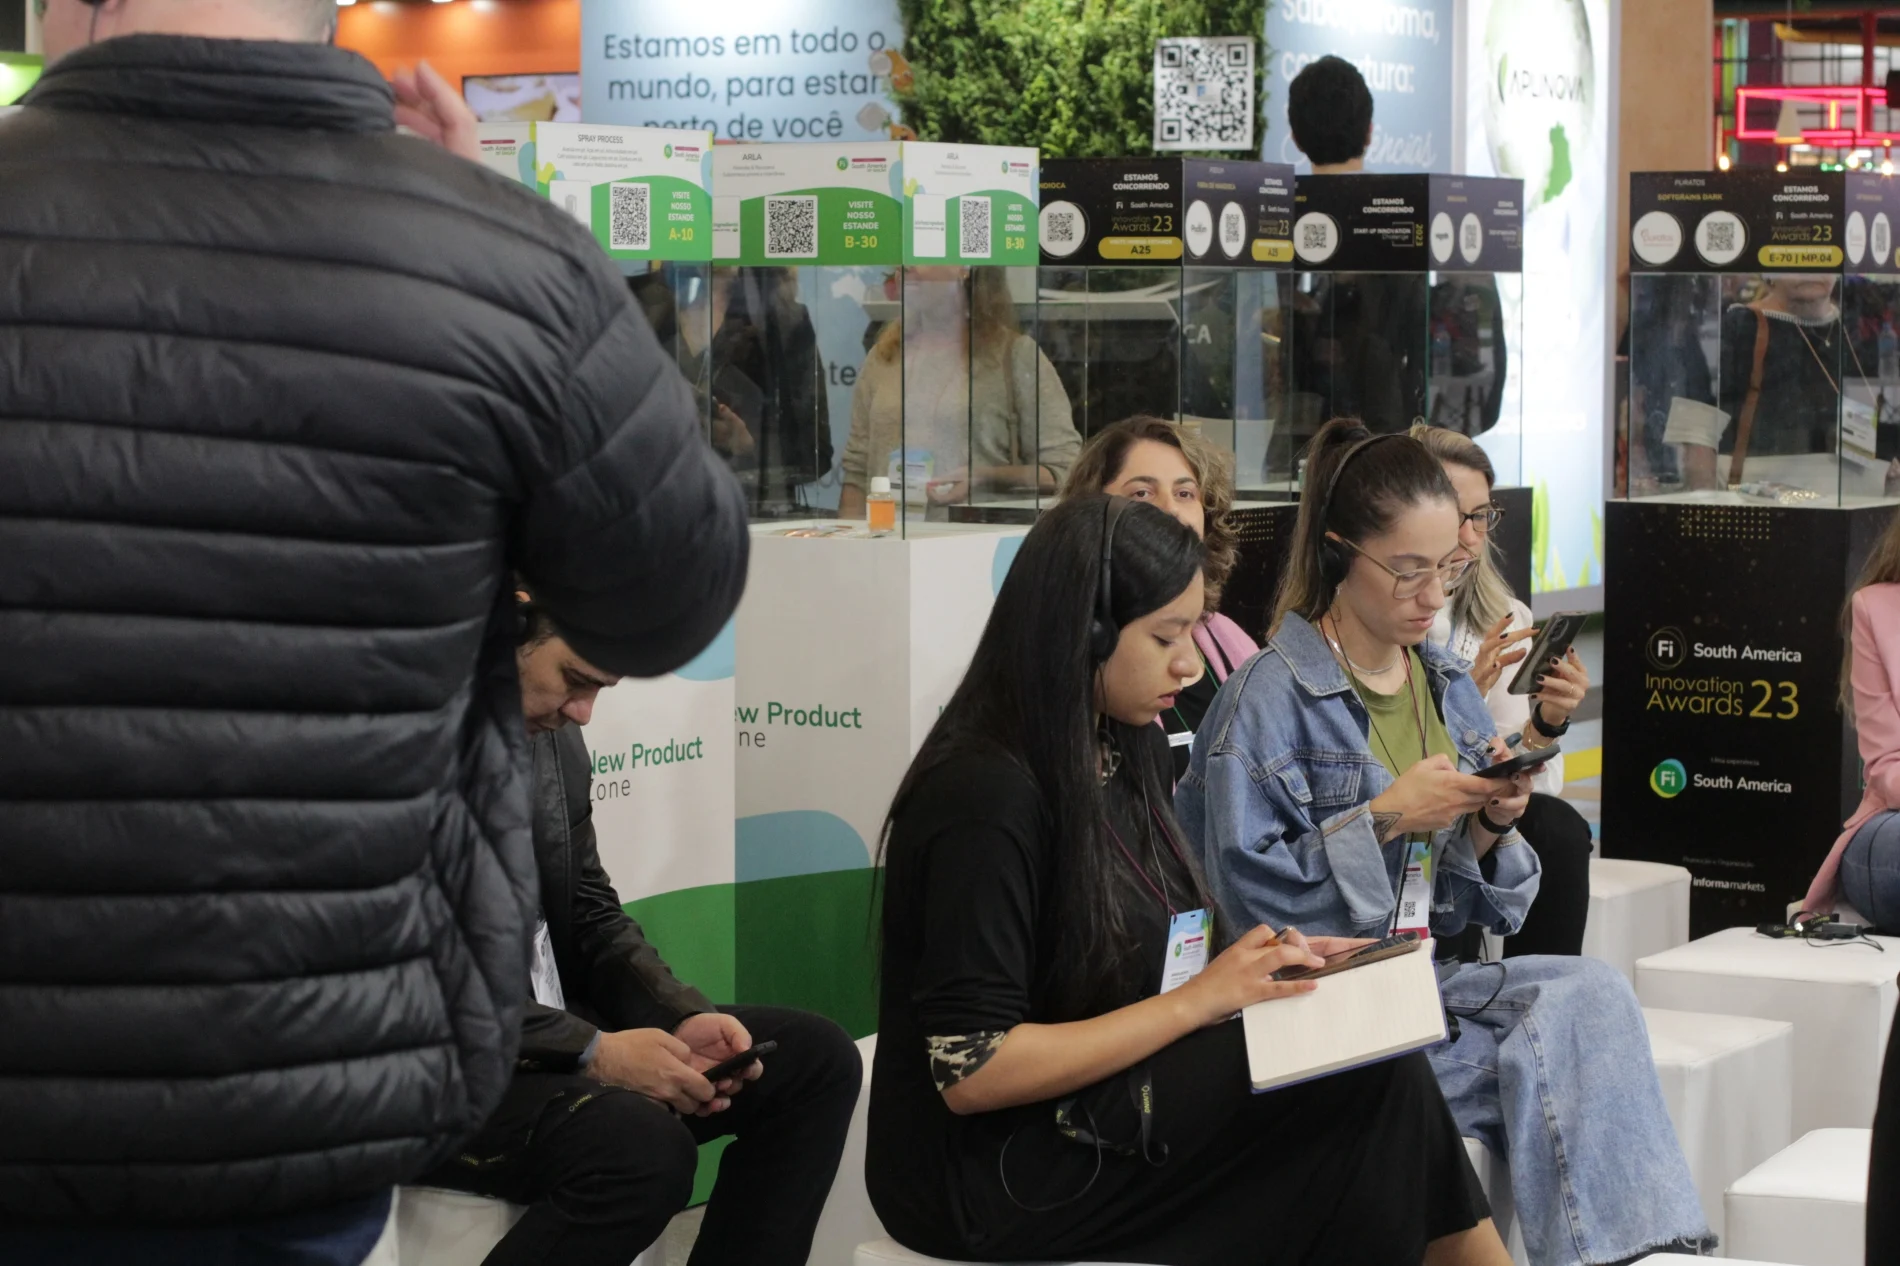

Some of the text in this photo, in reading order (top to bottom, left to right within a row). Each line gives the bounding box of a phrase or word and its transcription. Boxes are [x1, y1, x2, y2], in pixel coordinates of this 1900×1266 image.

[604, 27, 886, 59] Estamos em todo o
[609, 70, 881, 106] mundo, para estar
[728, 114, 763, 139] de
[773, 111, 843, 139] você
[577, 134, 624, 144] SPRAY PROCESS
[1123, 173, 1159, 181] ESTAMOS
[1112, 182, 1170, 190] CONCORRENDO
[1783, 185, 1819, 193] ESTAMOS
[672, 191, 690, 199] VISITE
[1772, 194, 1830, 202] CONCORRENDO
[670, 202, 692, 210] NOSSO
[1116, 201, 1124, 209] Fi
[1362, 206, 1414, 214] CONCORRENDO
[668, 213, 694, 221] ESTANDE
[847, 211, 875, 219] NOSSO
[1790, 211, 1808, 219] South
[843, 222, 879, 230] ESTANDE
[1112, 215, 1173, 232] Awards 23
[1279, 219, 1289, 235] 23
[669, 228, 694, 241] A-10
[1415, 224, 1423, 247] 2023
[1812, 224, 1832, 241] 23
[844, 235, 878, 248] B-30
[1005, 237, 1025, 249] B-30
[1131, 245, 1151, 254] A25
[1769, 253, 1793, 262] E-70
[1801, 253, 1832, 262] MP.04
[1657, 640, 1674, 658] Fi
[1693, 642, 1802, 663] South America
[1646, 673, 1744, 694] Innovation
[1646, 679, 1800, 720] Awards 23
[767, 701, 862, 729] Product
[739, 731, 766, 748] ne
[632, 736, 703, 769] Product
[1660, 771, 1675, 787] Fi
[1693, 773, 1792, 794] South America
